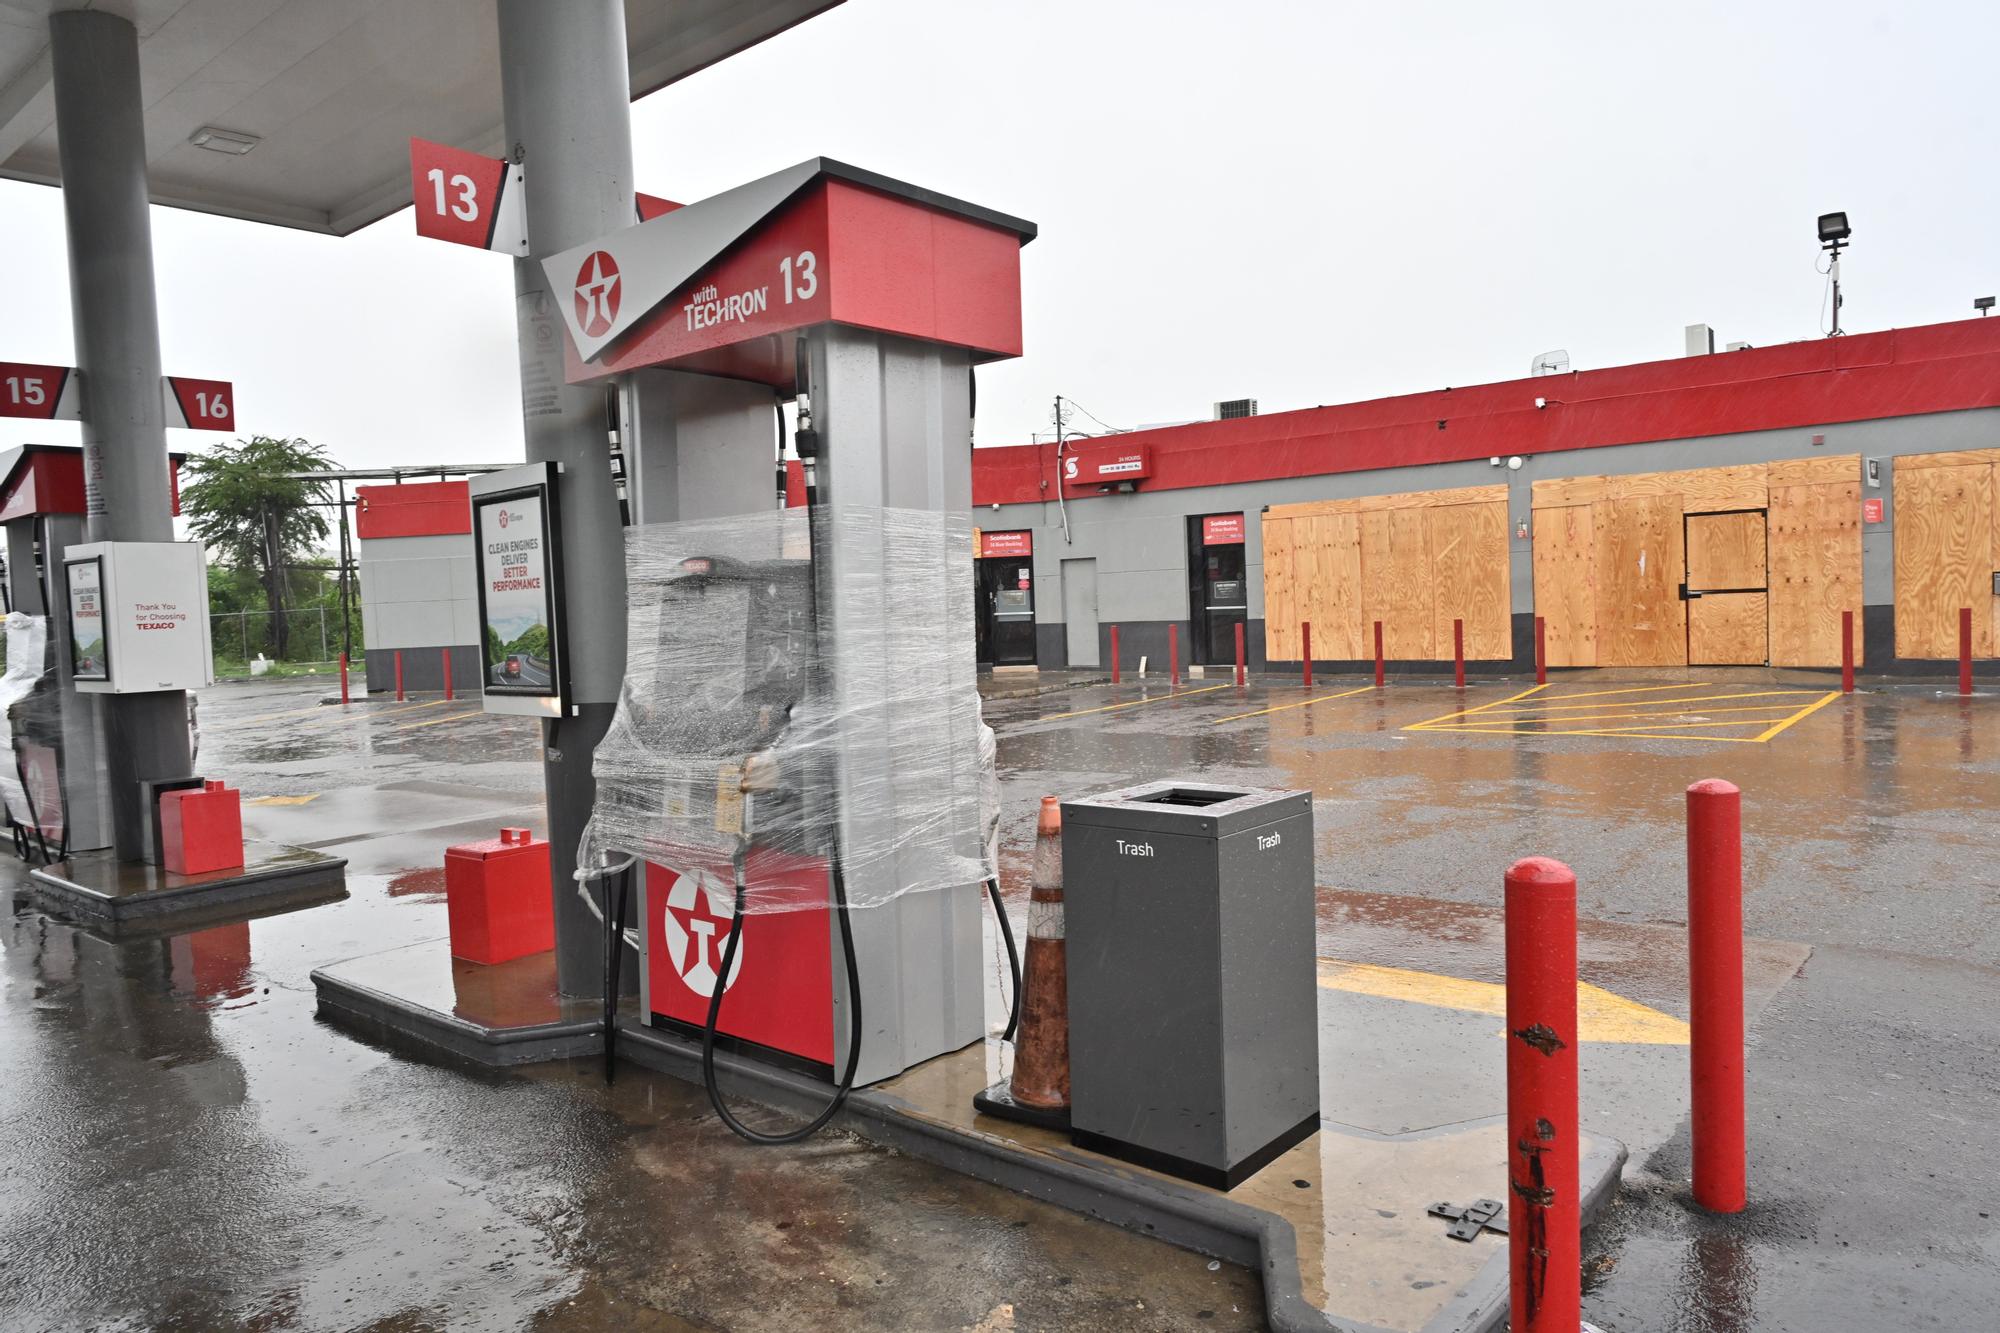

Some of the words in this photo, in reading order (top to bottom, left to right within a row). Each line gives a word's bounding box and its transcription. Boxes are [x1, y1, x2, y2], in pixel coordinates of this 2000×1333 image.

[428, 168, 479, 222] 13
[780, 250, 818, 305] 13
[693, 284, 718, 305] with
[684, 287, 767, 331] TECHRON
[6, 376, 45, 405] 15
[195, 392, 229, 419] 16
[488, 542, 510, 555] CLEAN
[510, 538, 539, 552] ENGINES
[501, 553, 529, 566] DELIVER
[503, 566, 529, 579] BETTER
[493, 577, 541, 592] PERFORMANCE
[136, 622, 176, 630] TEXACO
[150, 613, 186, 621] Choosing
[1116, 840, 1154, 857] Trash
[1257, 831, 1281, 851] Trash
